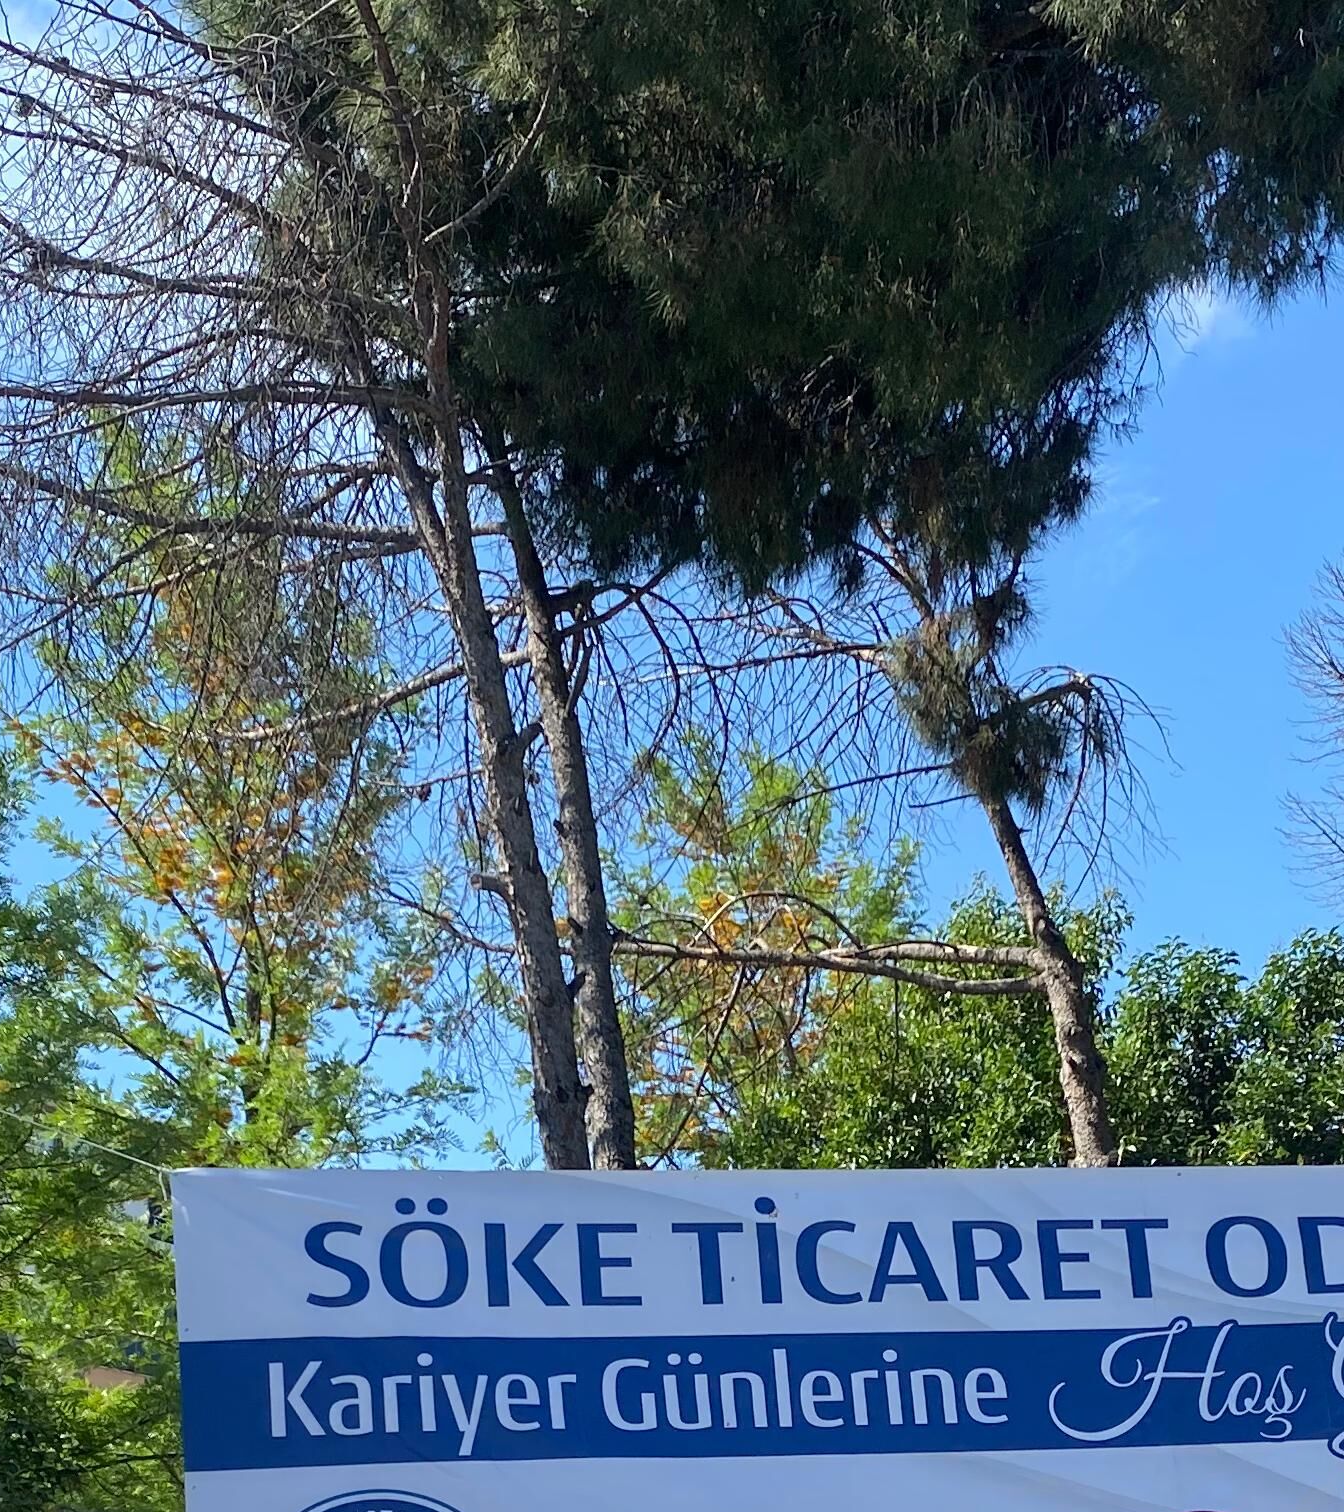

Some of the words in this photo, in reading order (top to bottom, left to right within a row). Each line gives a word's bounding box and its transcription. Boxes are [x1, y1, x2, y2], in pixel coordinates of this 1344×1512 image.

[304, 1197, 643, 1307] SÖKE
[672, 1196, 1168, 1304] TİCARET
[268, 1353, 576, 1456] Kariyer
[603, 1348, 1008, 1431] Günlerine
[1049, 1316, 1306, 1441] Hoş
